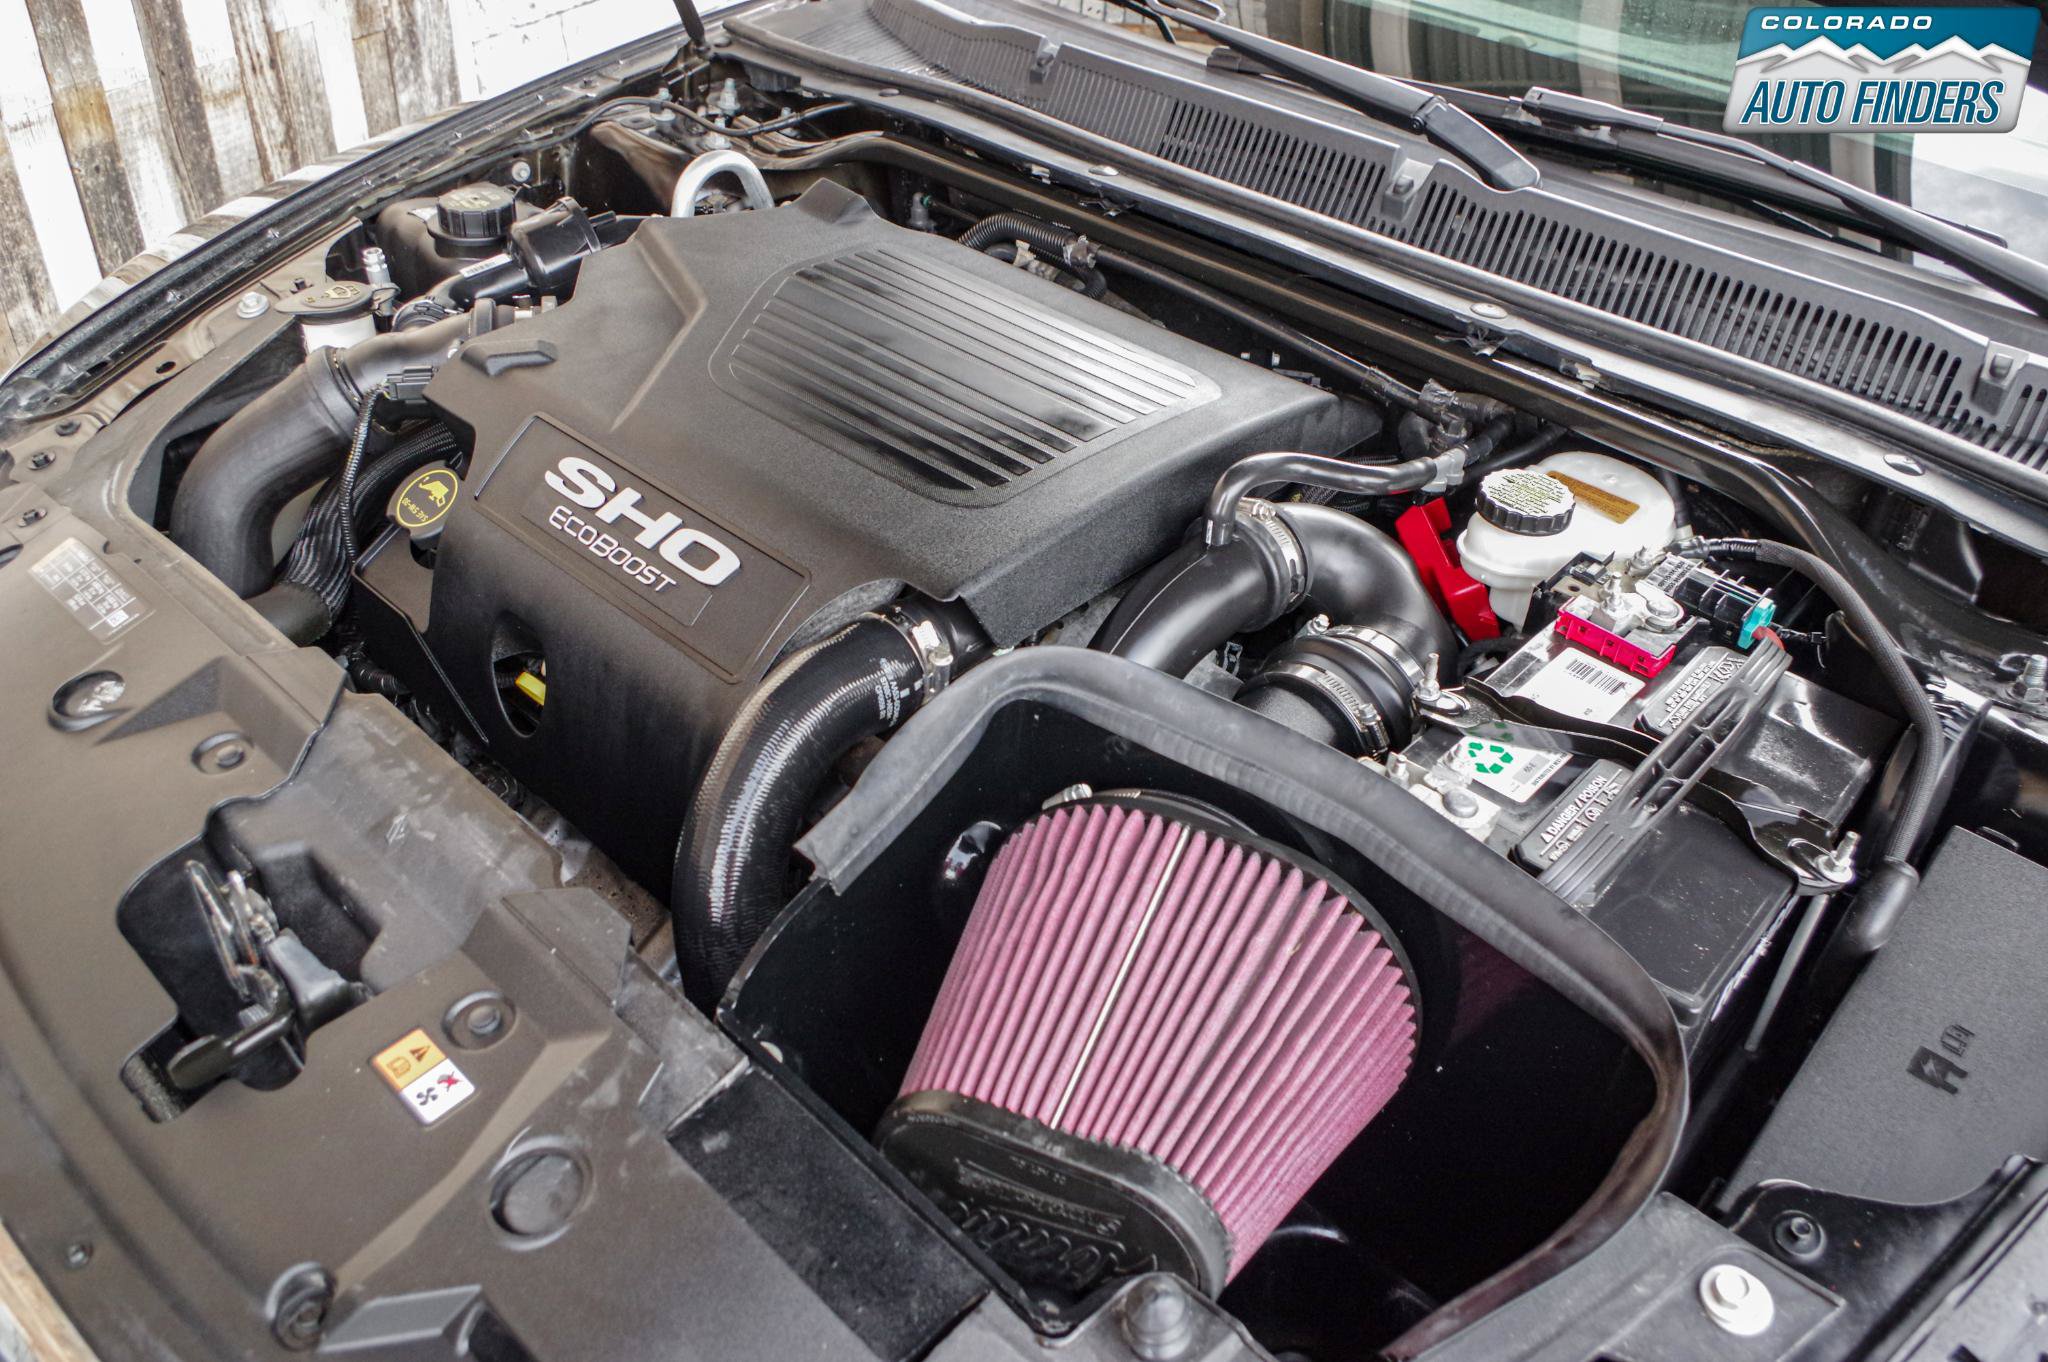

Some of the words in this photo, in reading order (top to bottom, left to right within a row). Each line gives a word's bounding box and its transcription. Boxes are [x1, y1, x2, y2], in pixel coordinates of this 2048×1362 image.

[545, 457, 741, 586] SHO
[549, 505, 676, 592] ECOBOOST
[1548, 803, 1579, 836] DANGER
[1579, 775, 1607, 802] POISON
